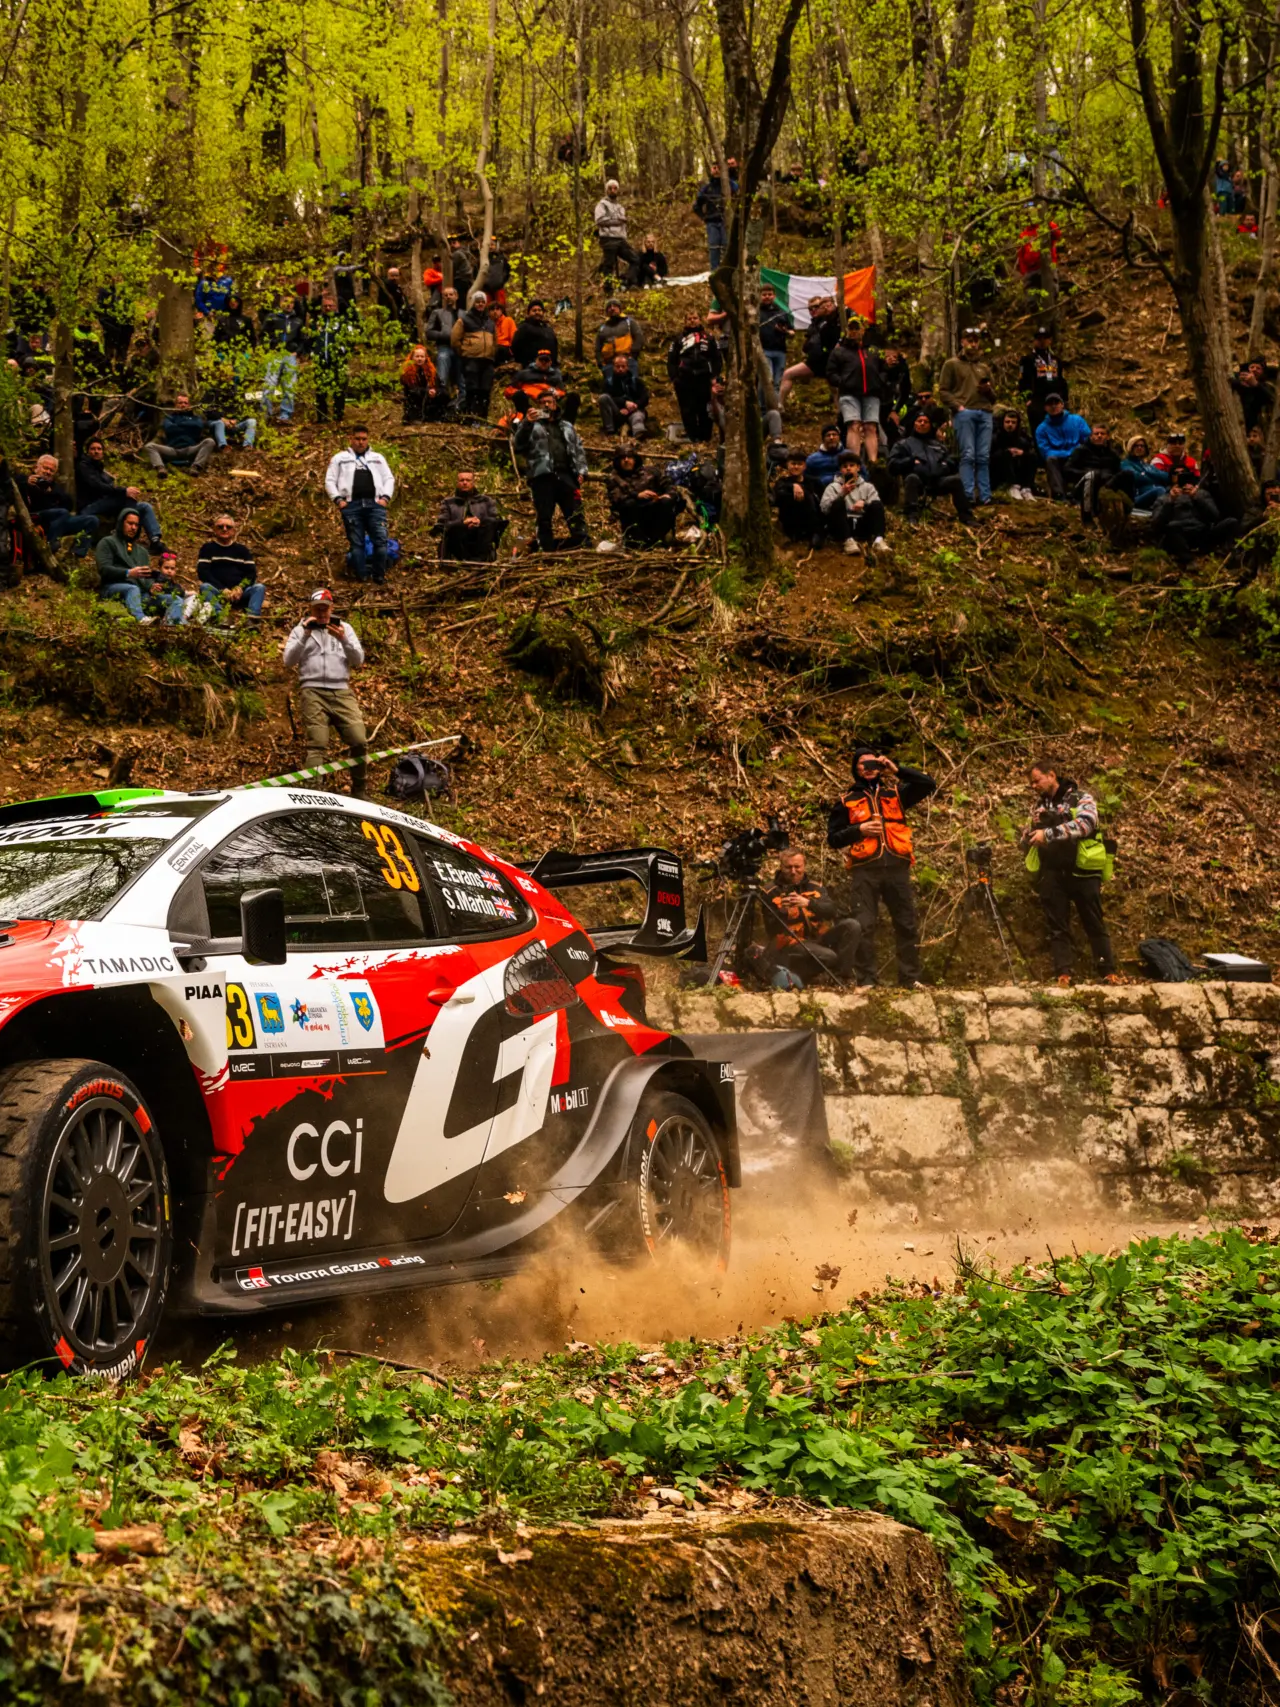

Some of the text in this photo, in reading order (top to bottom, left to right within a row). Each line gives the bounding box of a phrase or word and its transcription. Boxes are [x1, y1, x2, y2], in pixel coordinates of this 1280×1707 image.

[287, 794, 344, 807] PROTERIAL
[171, 841, 204, 872] CENTRAL
[361, 820, 420, 892] 33
[433, 861, 485, 889] E.Evans
[442, 887, 498, 917] S.Martin
[657, 891, 681, 907] DENSO
[83, 956, 174, 974] TAMADIC
[184, 984, 223, 1001] PIAA
[226, 983, 254, 1048] 3
[232, 1063, 256, 1073] WRC
[551, 1090, 578, 1114] Mobil
[287, 1118, 363, 1181] CCi
[269, 1269, 330, 1285] TOYOTA
[329, 1261, 380, 1275] GAZOO
[377, 1255, 426, 1267] Racing
